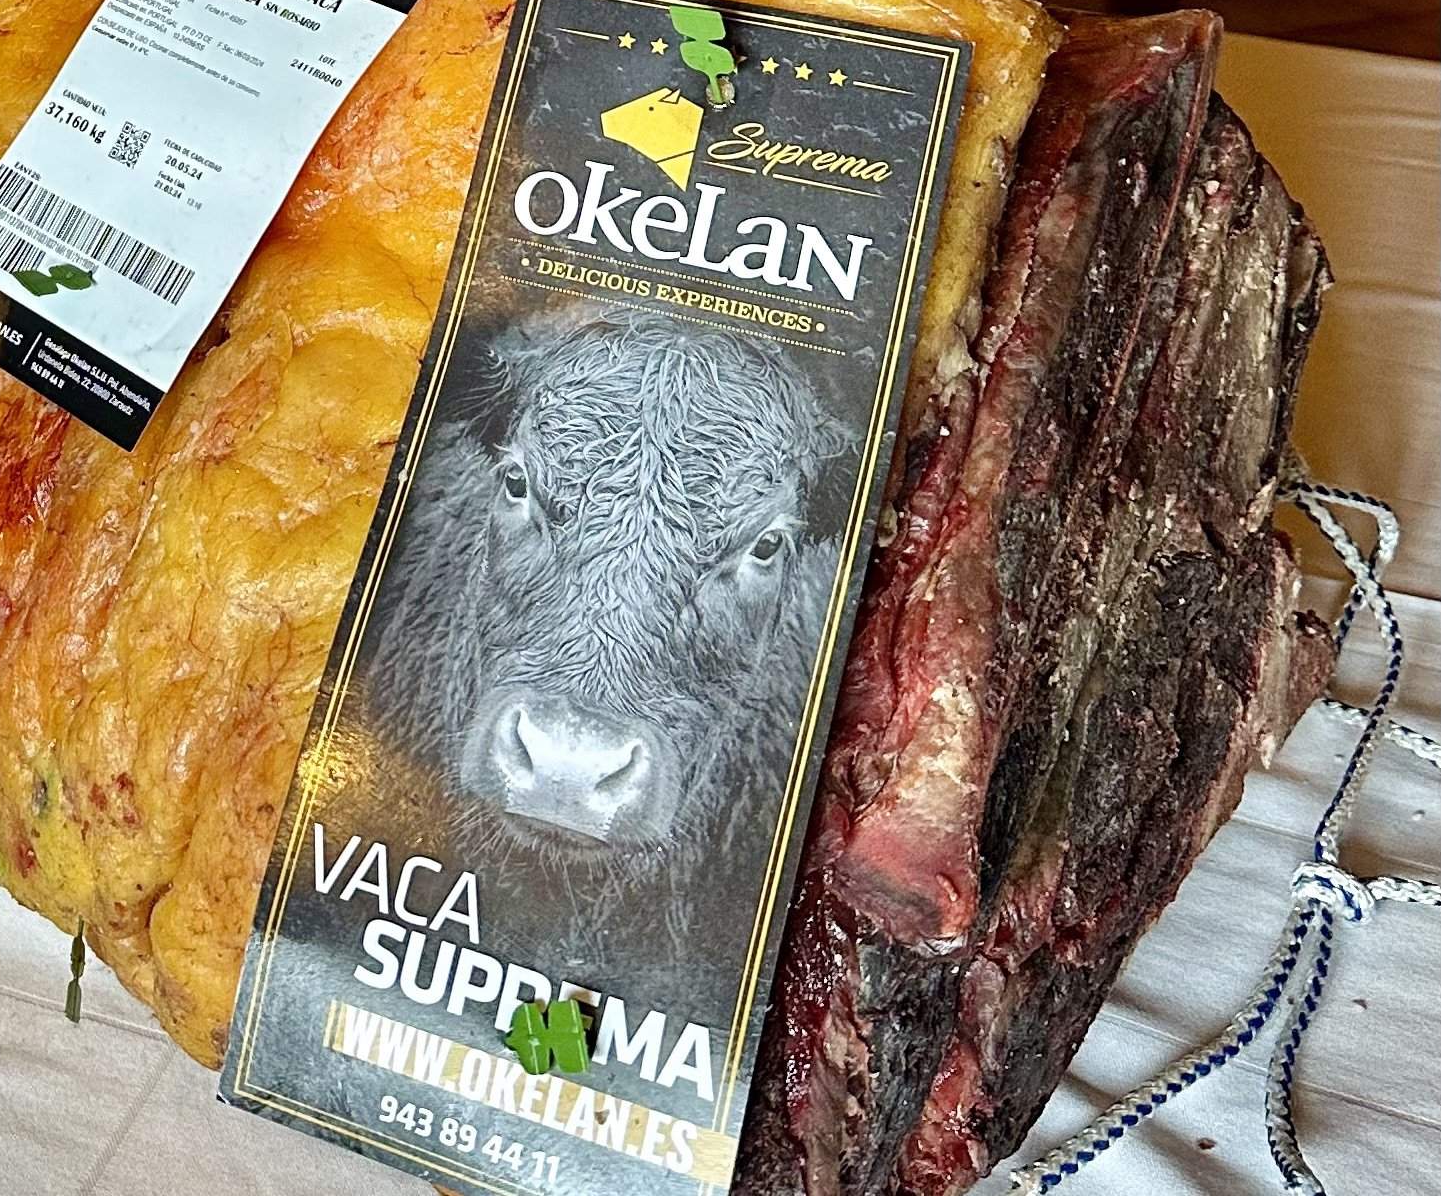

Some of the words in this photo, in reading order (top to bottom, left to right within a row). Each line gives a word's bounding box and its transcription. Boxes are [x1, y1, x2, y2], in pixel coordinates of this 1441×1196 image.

[97, 16, 127, 35] CONSEJOS
[143, 18, 167, 34] ESPAÑA
[147, 9, 178, 28] PORTUGAL
[263, 1, 280, 14] SIN
[279, 8, 321, 32] ROSARIO
[318, 54, 337, 68] LOTE
[62, 89, 92, 108] CANTIDAD
[44, 101, 90, 133] 37,160
[89, 123, 107, 145] kg
[164, 155, 204, 182] 20.05.24
[707, 122, 893, 184] Suprema
[537, 258, 652, 297] DELICIOUS
[655, 284, 813, 333] EXPERIENCES
[314, 822, 481, 945] VACA
[342, 1004, 698, 1175] WWW.OKELAN.ES
[378, 1094, 435, 1138] 943
[438, 1117, 477, 1153] 89
[482, 1135, 524, 1171] 44
[531, 1150, 560, 1182] 11
